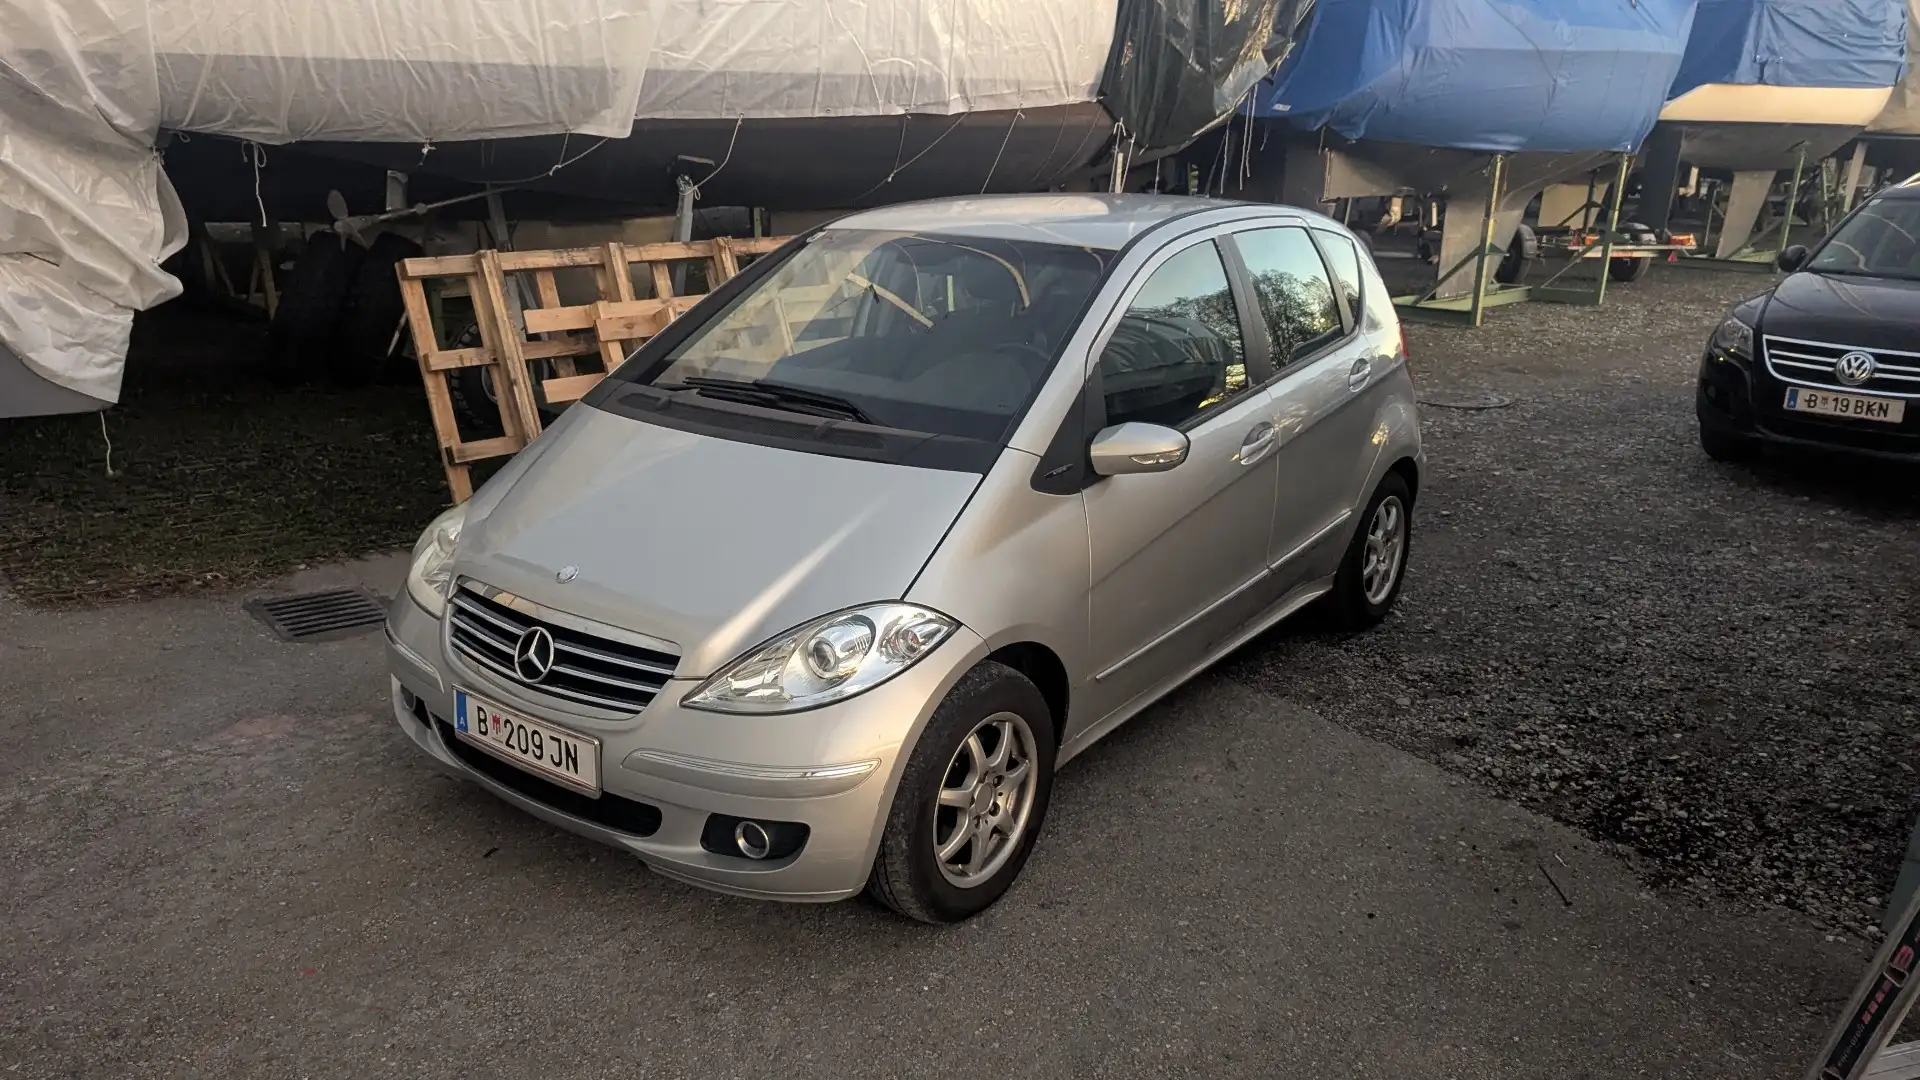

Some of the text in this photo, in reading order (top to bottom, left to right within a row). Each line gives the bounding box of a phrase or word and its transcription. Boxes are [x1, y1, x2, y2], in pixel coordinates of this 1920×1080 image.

[1840, 354, 1872, 382] VW
[1808, 393, 1889, 418] B 19 BKN
[459, 717, 465, 726] A
[476, 705, 578, 775] B 209 JN
